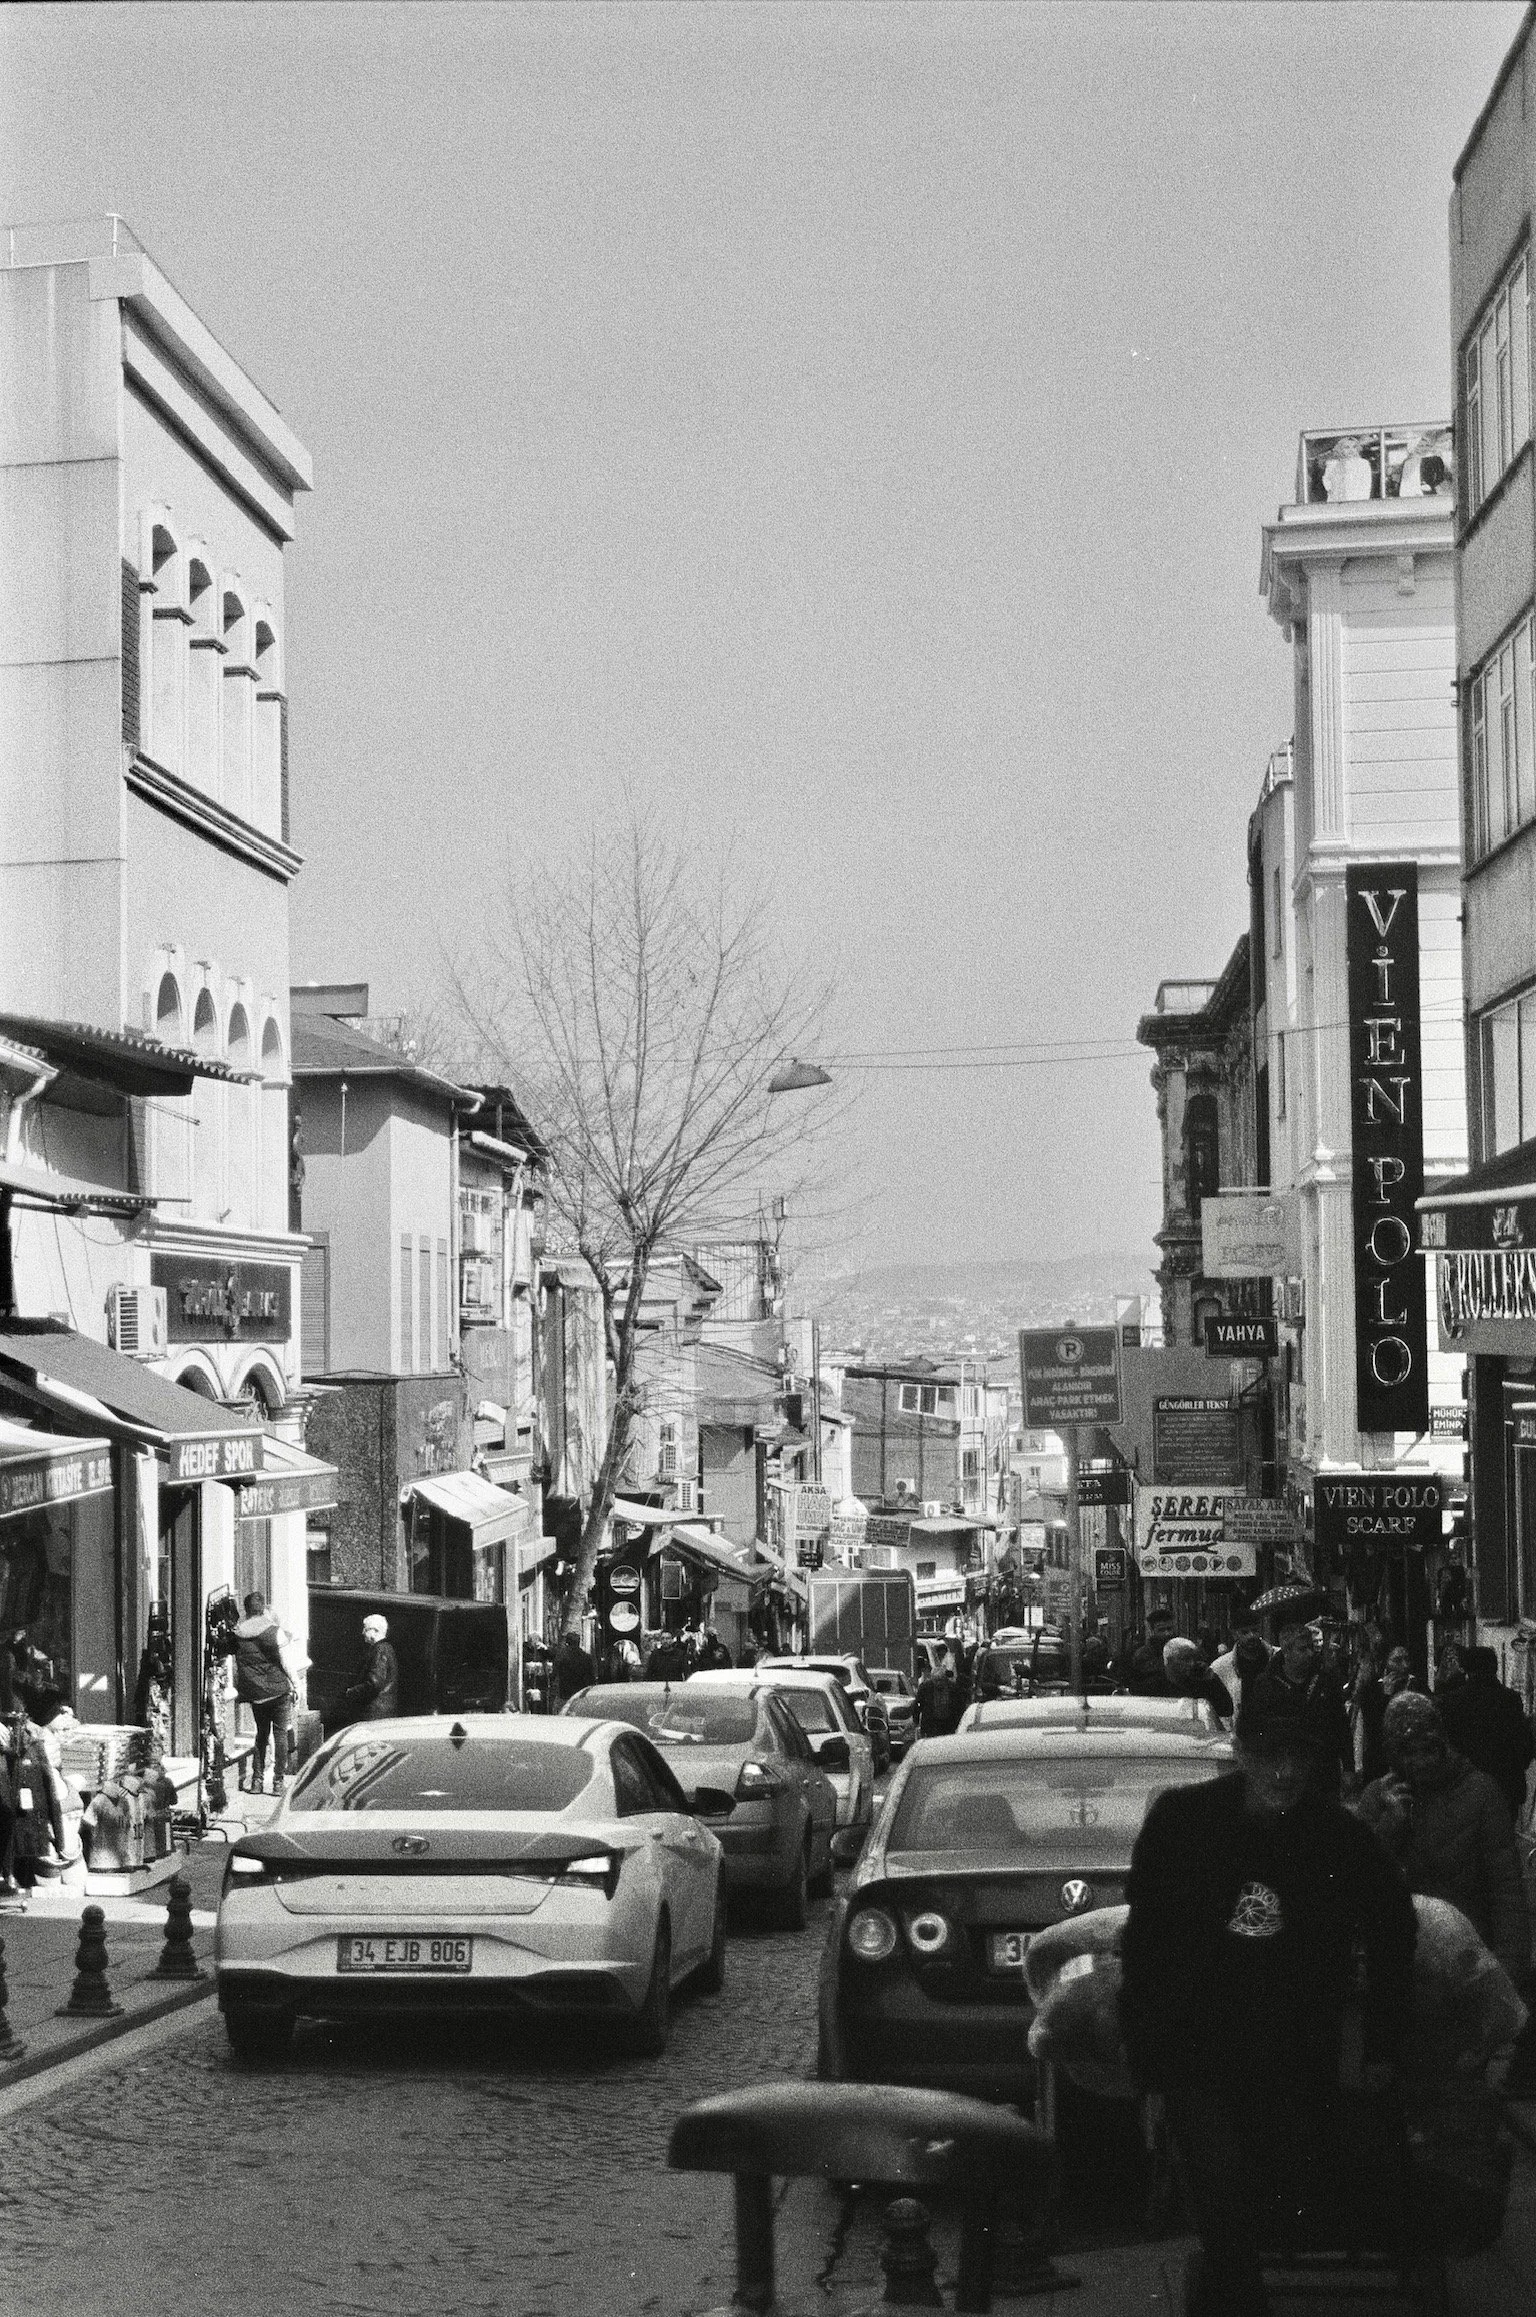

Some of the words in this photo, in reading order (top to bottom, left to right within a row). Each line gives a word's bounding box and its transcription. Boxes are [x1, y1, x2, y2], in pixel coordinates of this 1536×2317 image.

[1364, 1157, 1413, 1386] POLO
[1217, 1325, 1265, 1341] YAHYA
[1159, 1398, 1204, 1410] GÜNGÖRLER
[180, 1443, 219, 1477] HEDEF
[225, 1440, 254, 1472] SPOR
[801, 1485, 826, 1495] AKSA
[1381, 1486, 1439, 1508] POLO
[1347, 1517, 1416, 1533] SCARF
[1142, 1523, 1224, 1549] fermua
[1101, 1562, 1121, 1570] MISS
[354, 1941, 375, 1962] 34
[386, 1941, 420, 1962] EJB
[430, 1941, 465, 1962] 806
